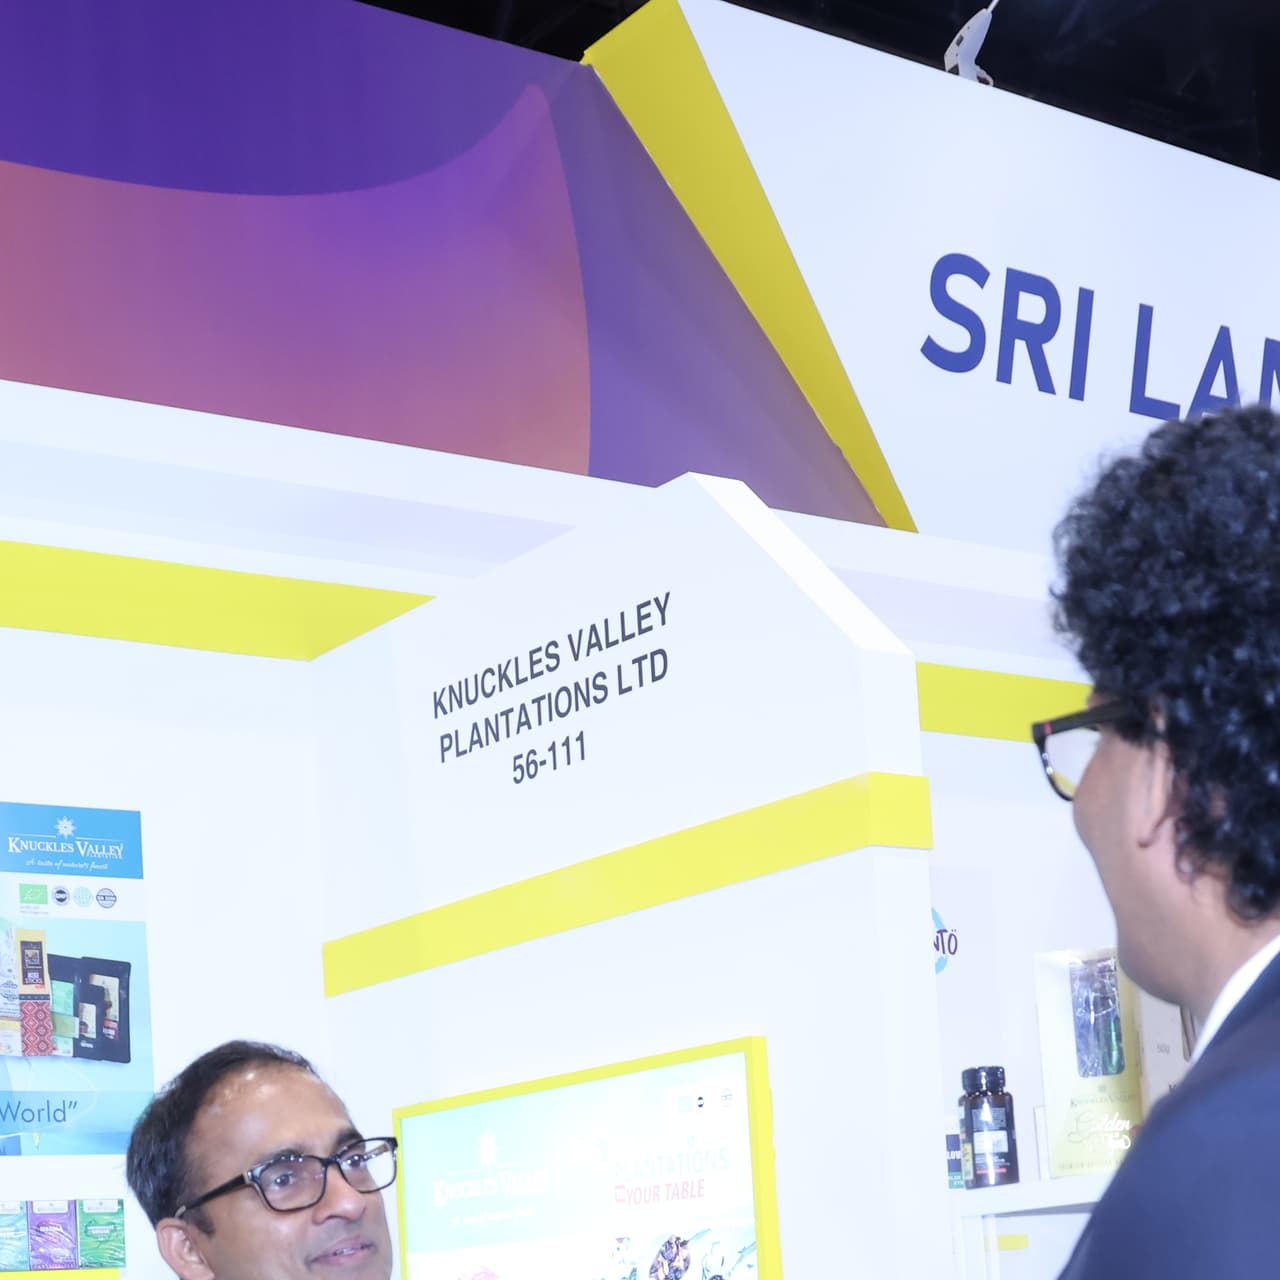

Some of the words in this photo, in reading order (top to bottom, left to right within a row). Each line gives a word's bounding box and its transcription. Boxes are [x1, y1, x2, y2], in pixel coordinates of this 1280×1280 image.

[920, 252, 1095, 402] SRI
[433, 640, 560, 719] KNUCKLES
[567, 592, 670, 661] VALLEY
[440, 671, 608, 763] PLANTATIONS
[617, 649, 668, 695] LTD
[513, 730, 585, 784] 56-111
[8, 837, 74, 853] KNUCKLES
[76, 841, 123, 858] VALLEY
[627, 1184, 660, 1206] YOUR
[664, 1179, 704, 1200] TABLE
